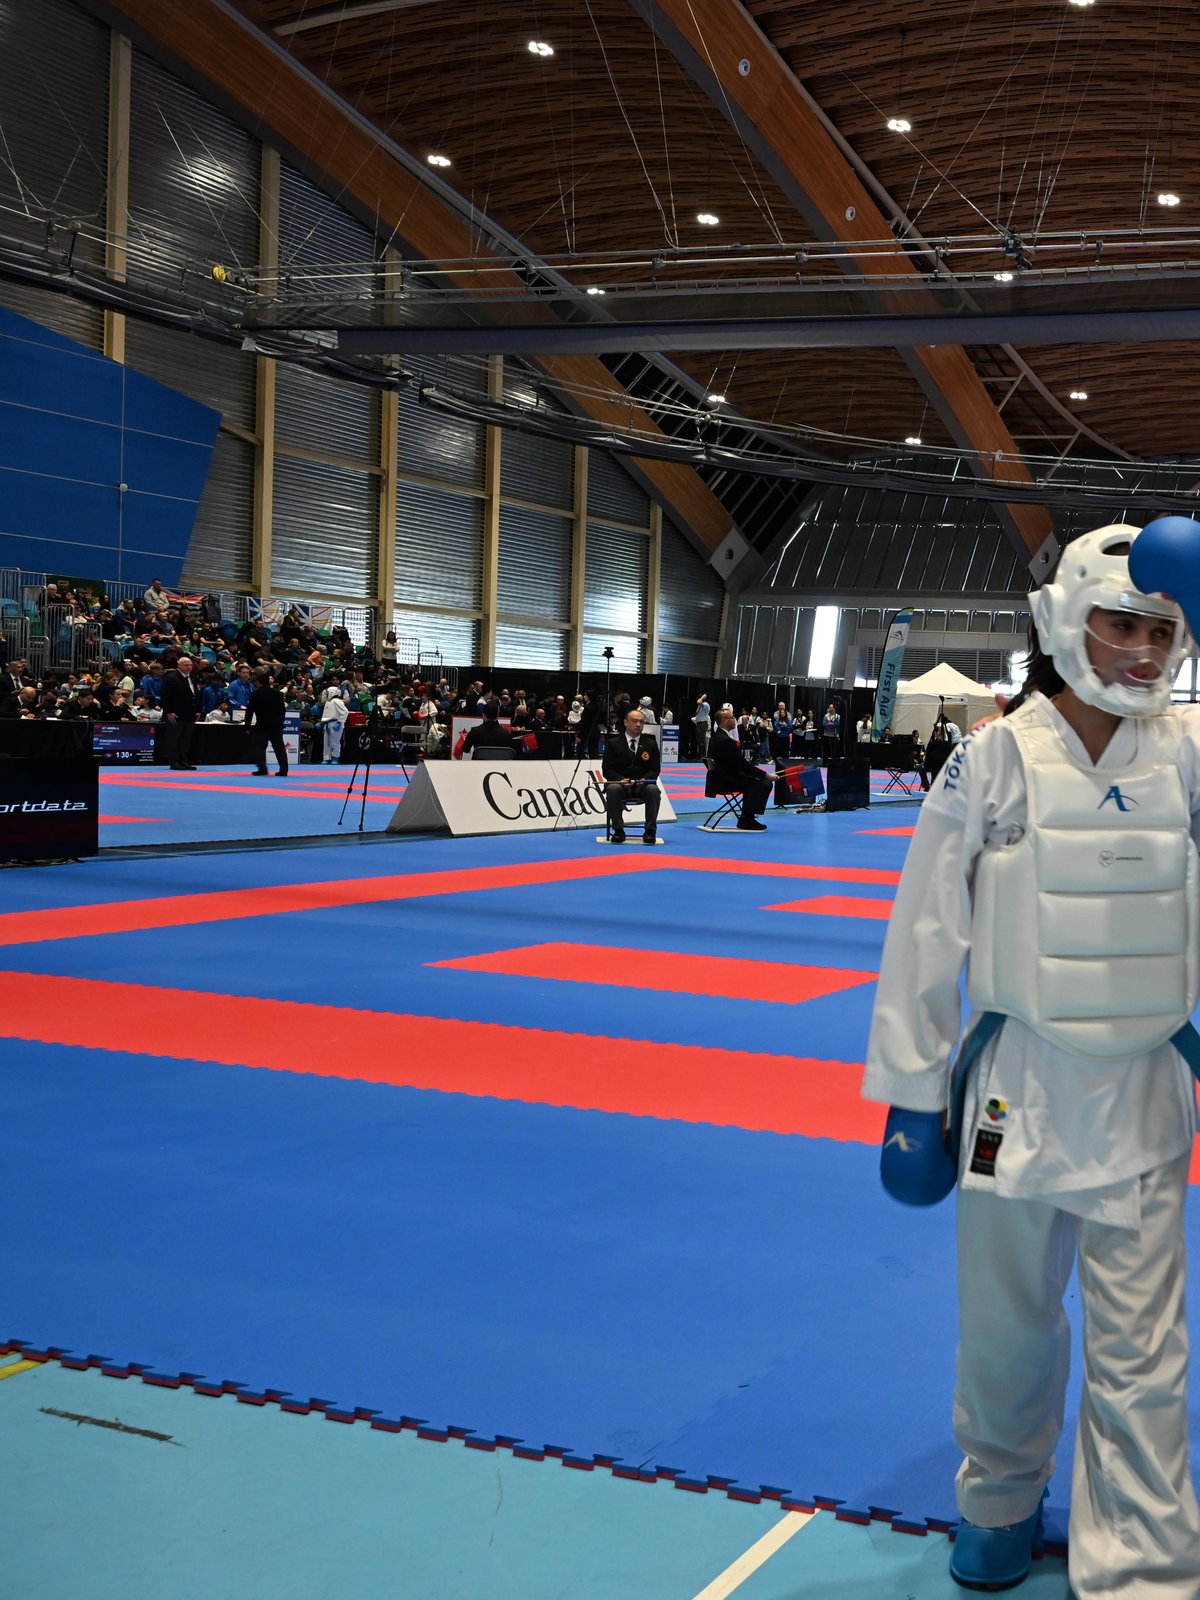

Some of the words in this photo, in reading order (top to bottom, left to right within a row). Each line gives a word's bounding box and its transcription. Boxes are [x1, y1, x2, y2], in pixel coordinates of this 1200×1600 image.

[882, 662, 896, 693] First
[879, 695, 890, 720] Aid
[482, 769, 633, 821] Canad
